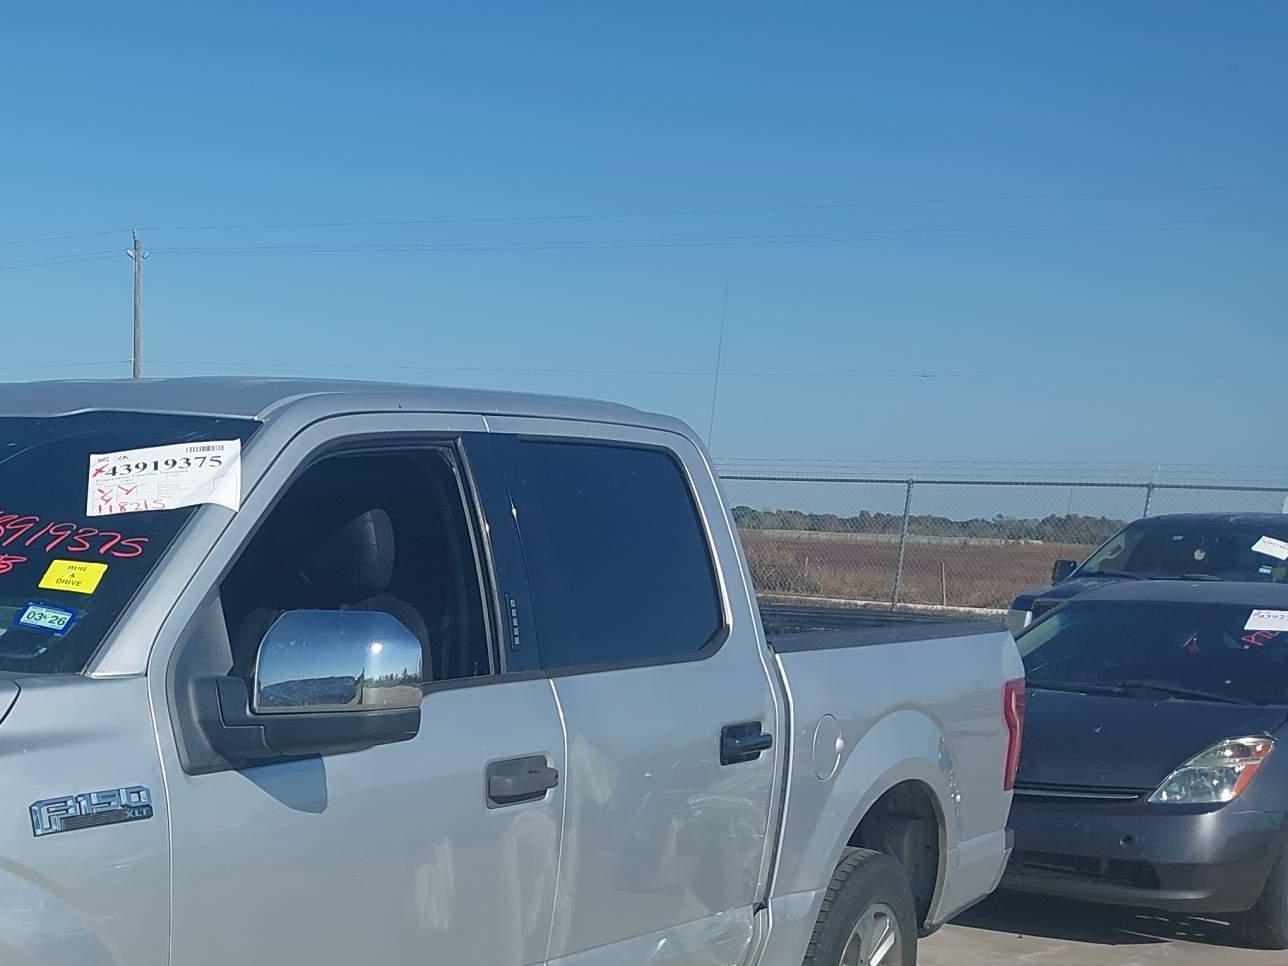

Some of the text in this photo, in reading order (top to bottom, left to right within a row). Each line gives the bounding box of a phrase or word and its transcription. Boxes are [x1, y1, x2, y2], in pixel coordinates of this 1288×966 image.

[105, 455, 223, 477] 43919375
[55, 577, 83, 587] DRIVE
[26, 610, 68, 626] 03 26
[125, 806, 150, 819] XLT
